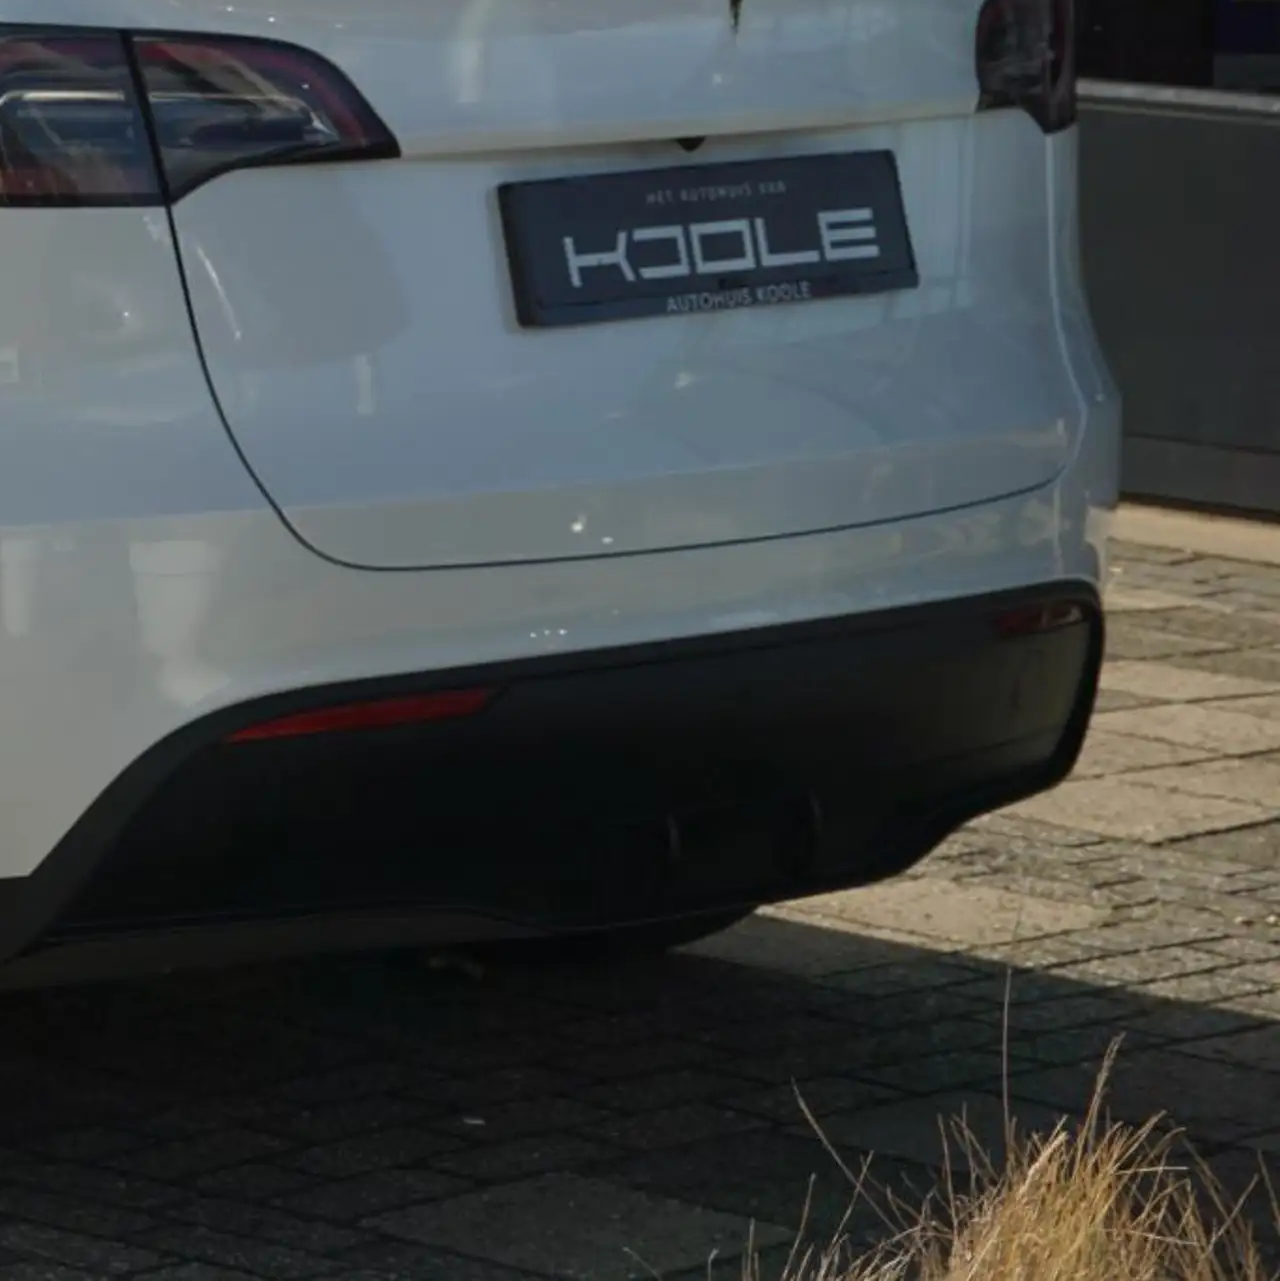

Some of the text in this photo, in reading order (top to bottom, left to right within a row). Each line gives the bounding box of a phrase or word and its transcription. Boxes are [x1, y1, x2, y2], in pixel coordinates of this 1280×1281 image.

[563, 207, 880, 288] KOOLE
[666, 279, 813, 313] AUTOHUIS KOOLE
